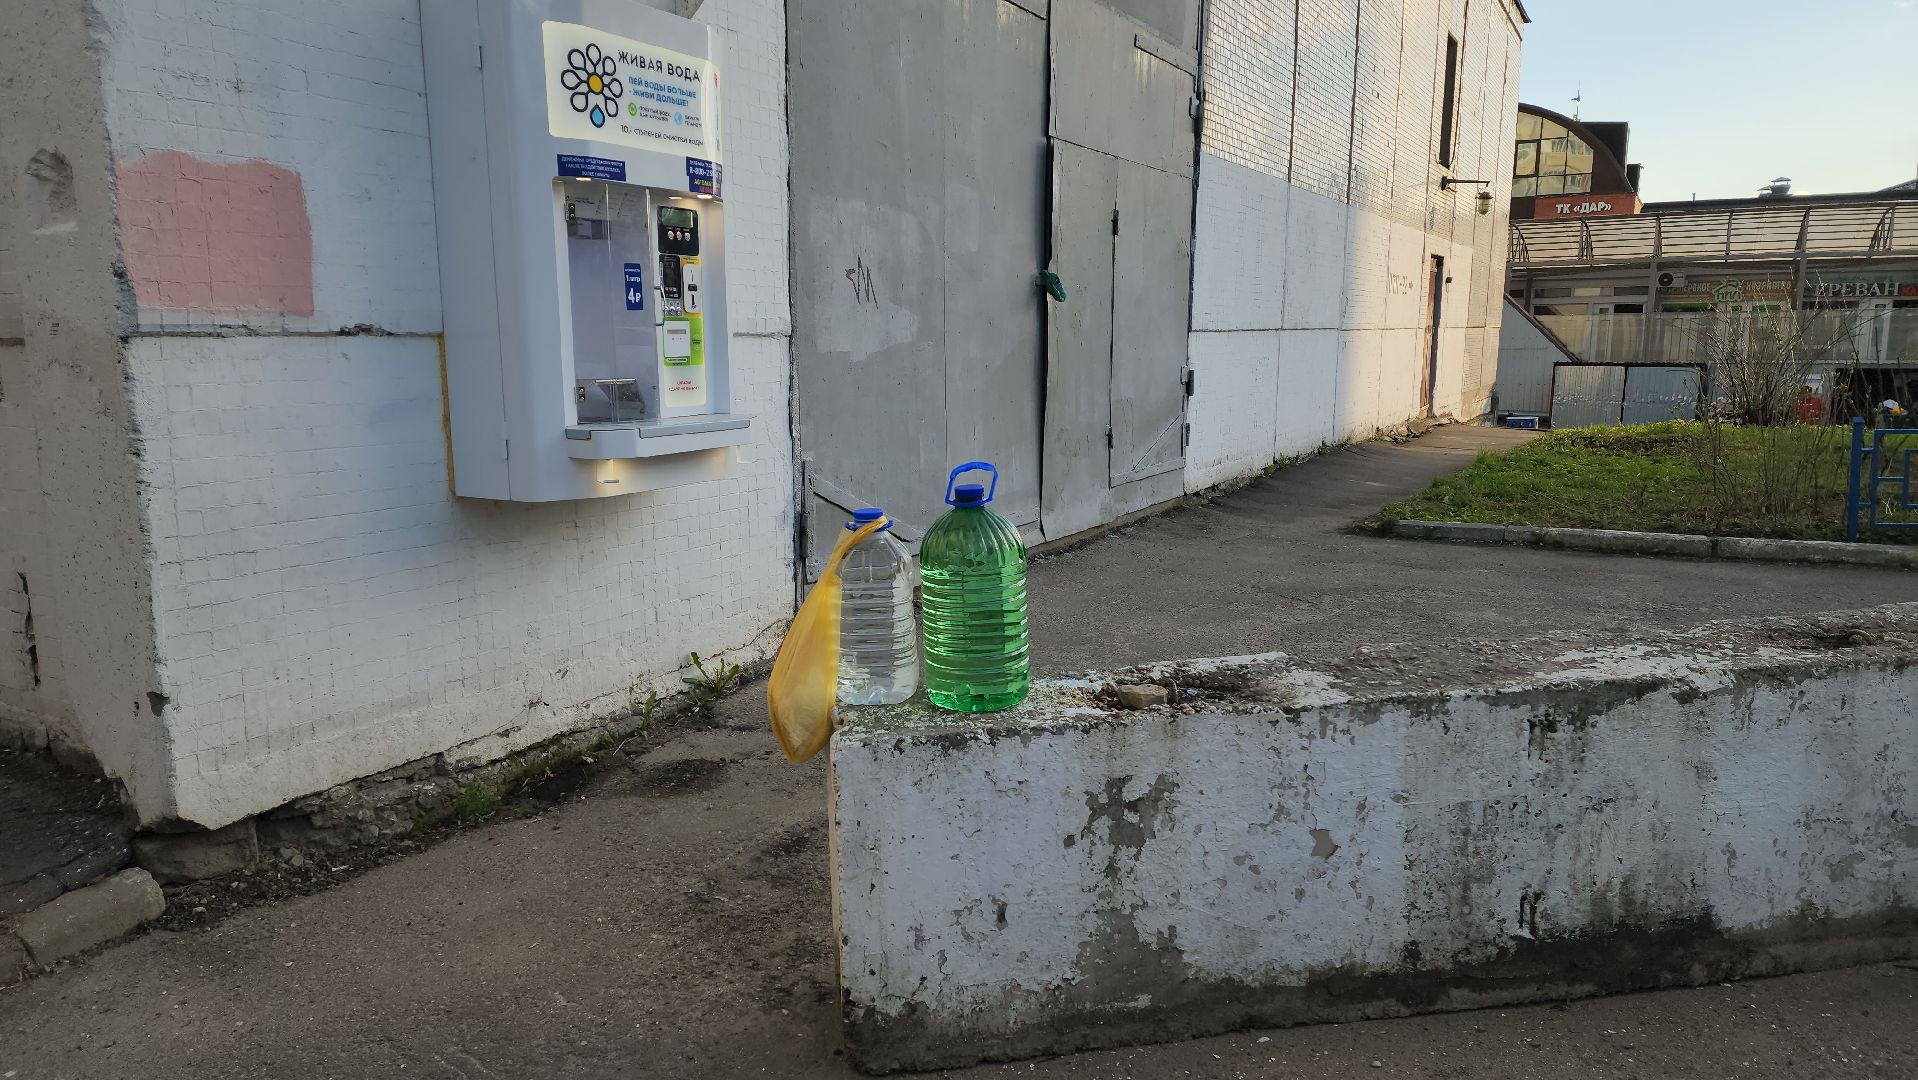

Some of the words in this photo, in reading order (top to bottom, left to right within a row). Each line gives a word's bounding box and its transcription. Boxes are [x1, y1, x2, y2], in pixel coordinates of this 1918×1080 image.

[617, 49, 663, 73] ЖИВАЯ
[667, 62, 701, 83] ВОДА
[628, 76, 643, 87] ПЕЙ
[644, 79, 666, 93] ВОДЫ
[667, 84, 697, 98] БОЛЬШЕ
[632, 89, 655, 99] ЖИВИ
[656, 94, 689, 107] ДОЛЬШЕ!
[1555, 203, 1571, 214] ТК
[1573, 201, 1612, 214] «ДАР»
